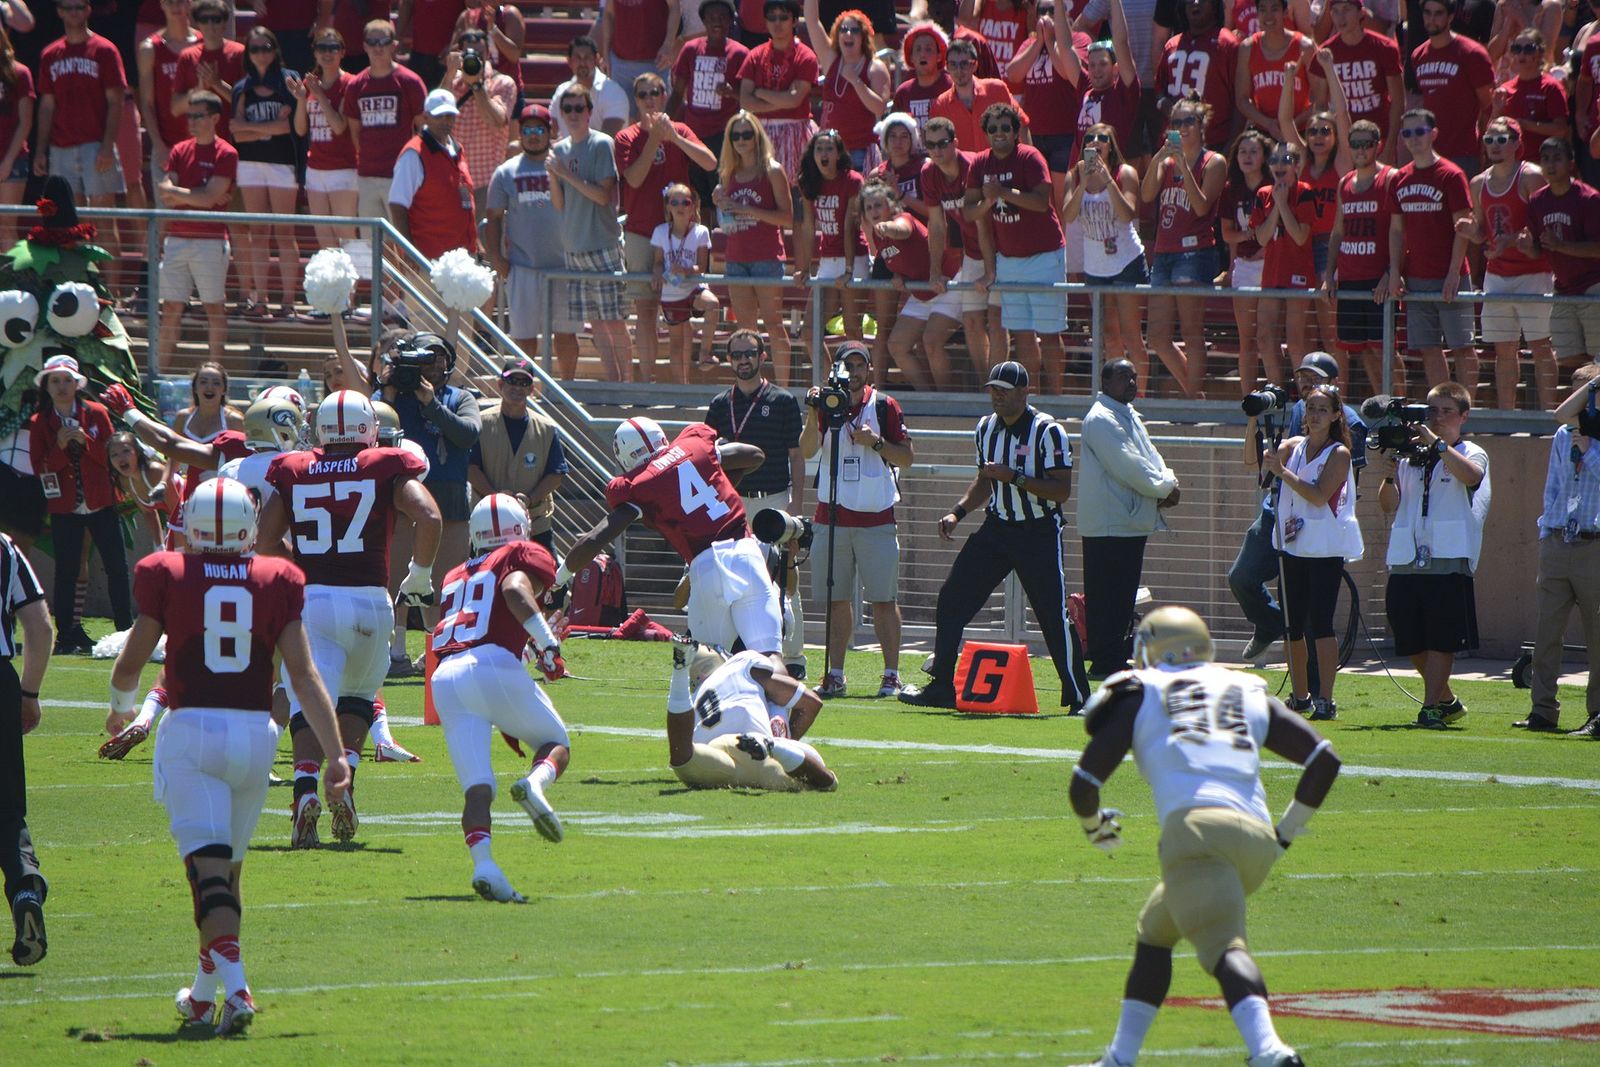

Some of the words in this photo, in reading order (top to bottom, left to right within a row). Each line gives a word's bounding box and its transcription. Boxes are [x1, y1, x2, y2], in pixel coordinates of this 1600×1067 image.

[50, 57, 98, 82] STANFORD
[1167, 50, 1210, 97] 33
[1333, 60, 1377, 80] FEAR
[1416, 61, 1459, 77] STANFORD
[360, 98, 396, 111] RED
[1396, 184, 1444, 202] STANFORD
[761, 405, 771, 417] S
[308, 457, 359, 475] CASPERS
[677, 459, 731, 522] 4
[292, 479, 376, 555] 57
[204, 563, 247, 579] HOGAN
[204, 585, 253, 673] 8
[962, 649, 1009, 703] G
